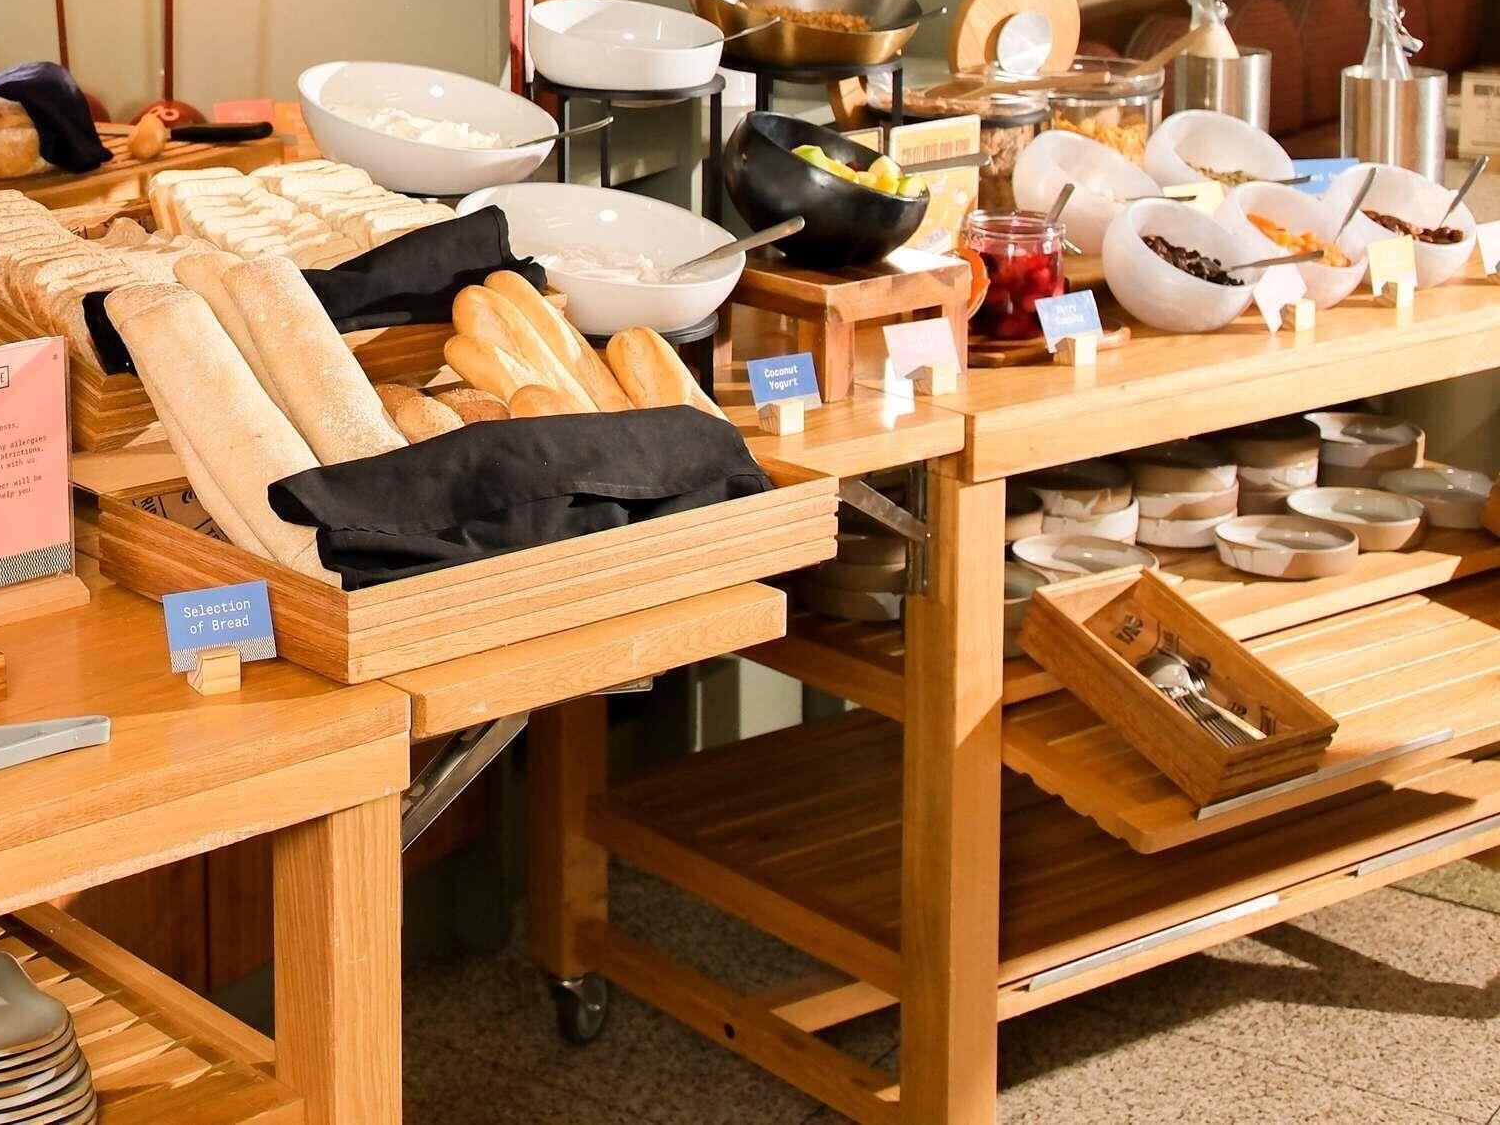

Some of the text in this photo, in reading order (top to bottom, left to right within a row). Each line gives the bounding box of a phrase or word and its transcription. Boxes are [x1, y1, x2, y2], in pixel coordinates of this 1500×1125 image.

[764, 365, 798, 378] Coconut
[768, 378, 799, 390] Yogurt
[10, 435, 47, 449] allergies
[7, 458, 23, 468] with
[13, 476, 30, 486] will
[33, 475, 42, 483] be
[183, 600, 251, 618] Selection
[190, 615, 250, 635] of Bread
